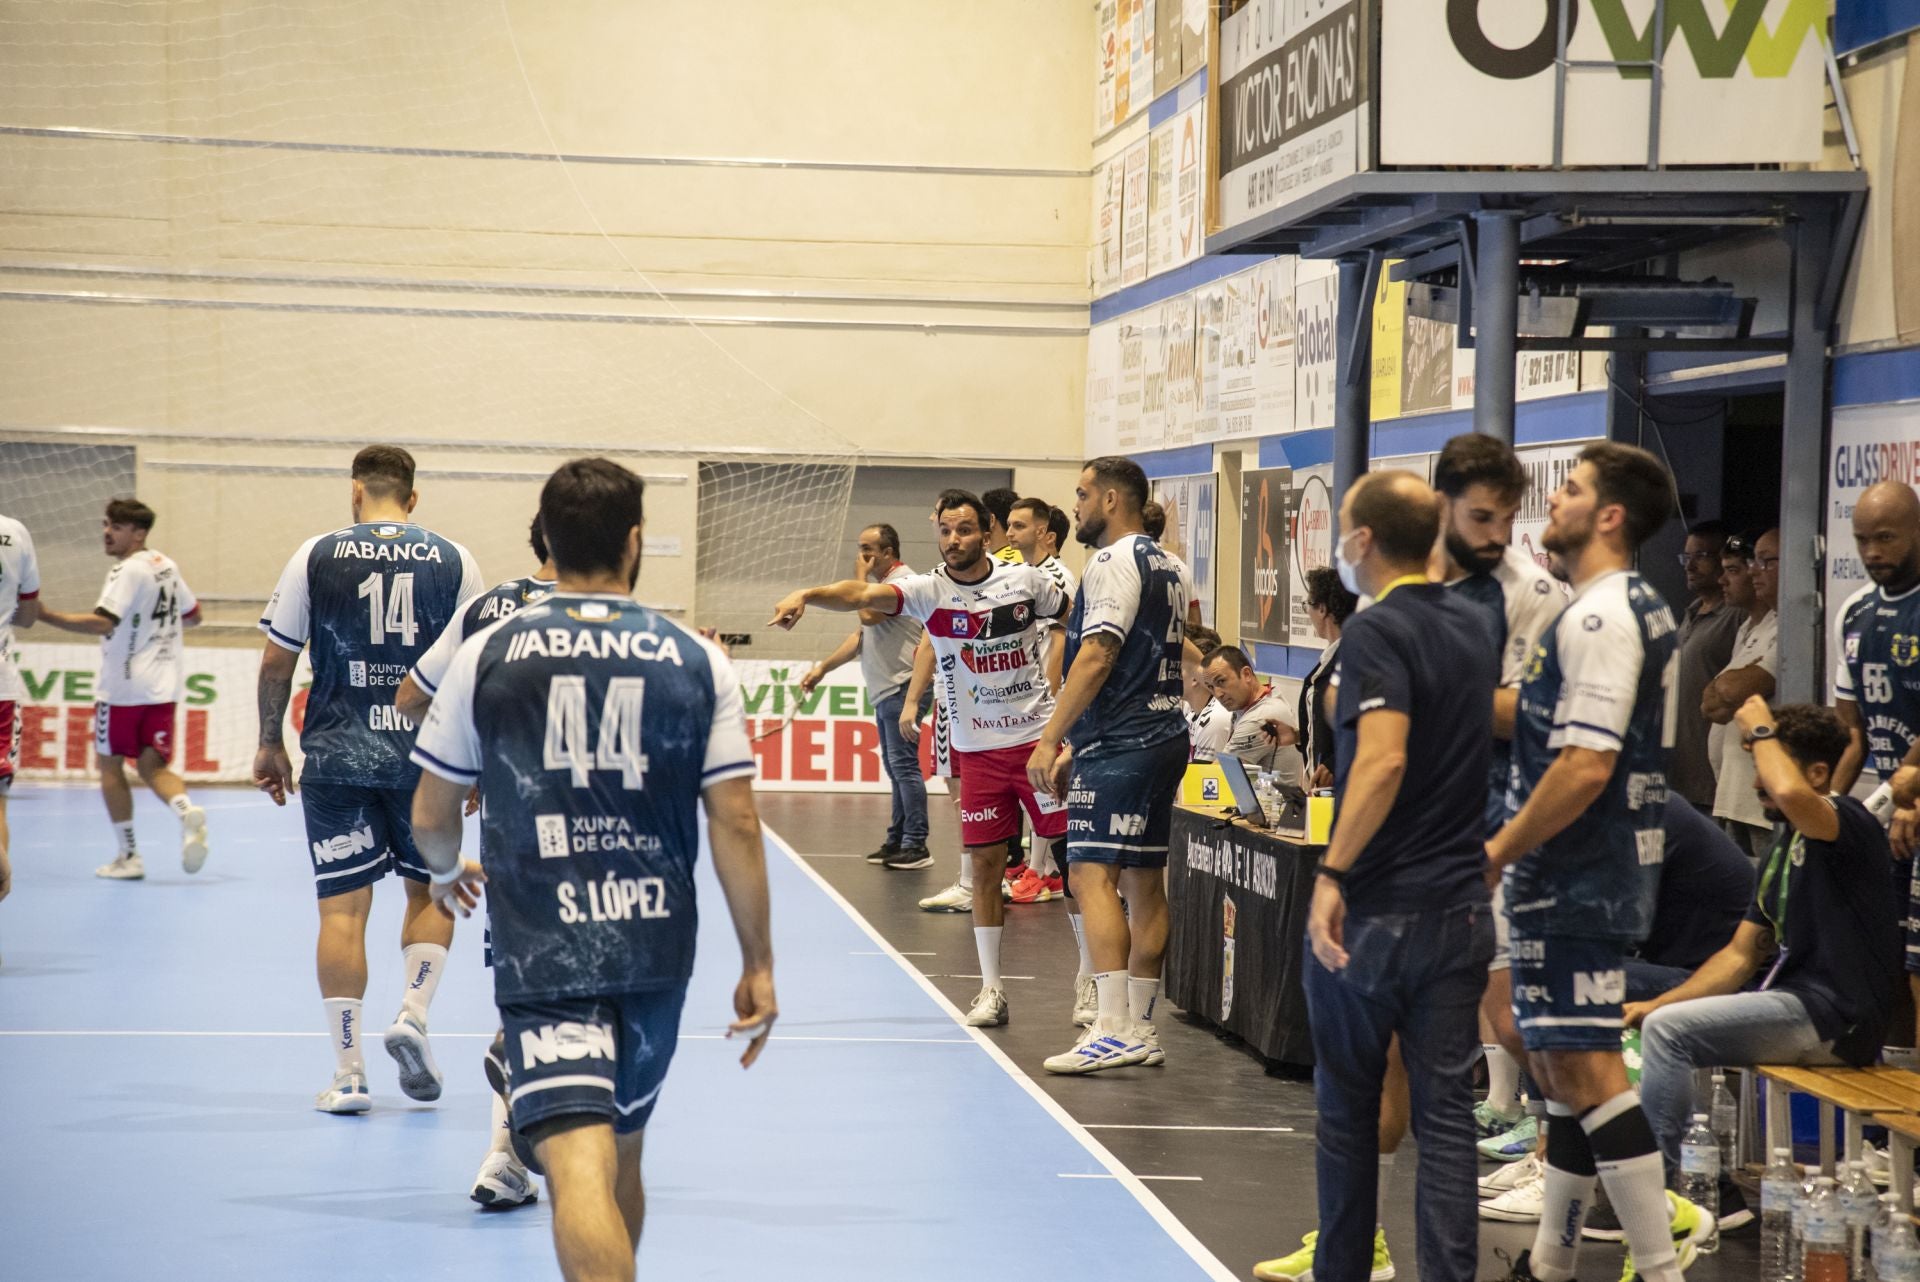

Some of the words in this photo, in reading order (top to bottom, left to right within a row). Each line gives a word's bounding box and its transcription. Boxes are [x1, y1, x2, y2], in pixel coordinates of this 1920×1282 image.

[1236, 64, 1281, 156] VICTOR
[1285, 13, 1355, 130] ENCINAS
[1529, 358, 1541, 385] 921
[358, 571, 420, 646] 14
[979, 609, 993, 638] 7
[369, 663, 408, 674] XUNTA
[975, 648, 1029, 674] HEROL
[369, 676, 384, 686] DE
[980, 680, 1032, 698] Cajaviva
[1862, 662, 1893, 703] 55
[543, 675, 649, 790] 44
[572, 817, 631, 832] XUNTA
[572, 835, 597, 852] DE
[557, 881, 586, 924] S.
[588, 870, 670, 922] LÓPEZ
[410, 960, 431, 989] Kempa
[342, 1009, 354, 1049] Kempa
[519, 1021, 615, 1070] NON
